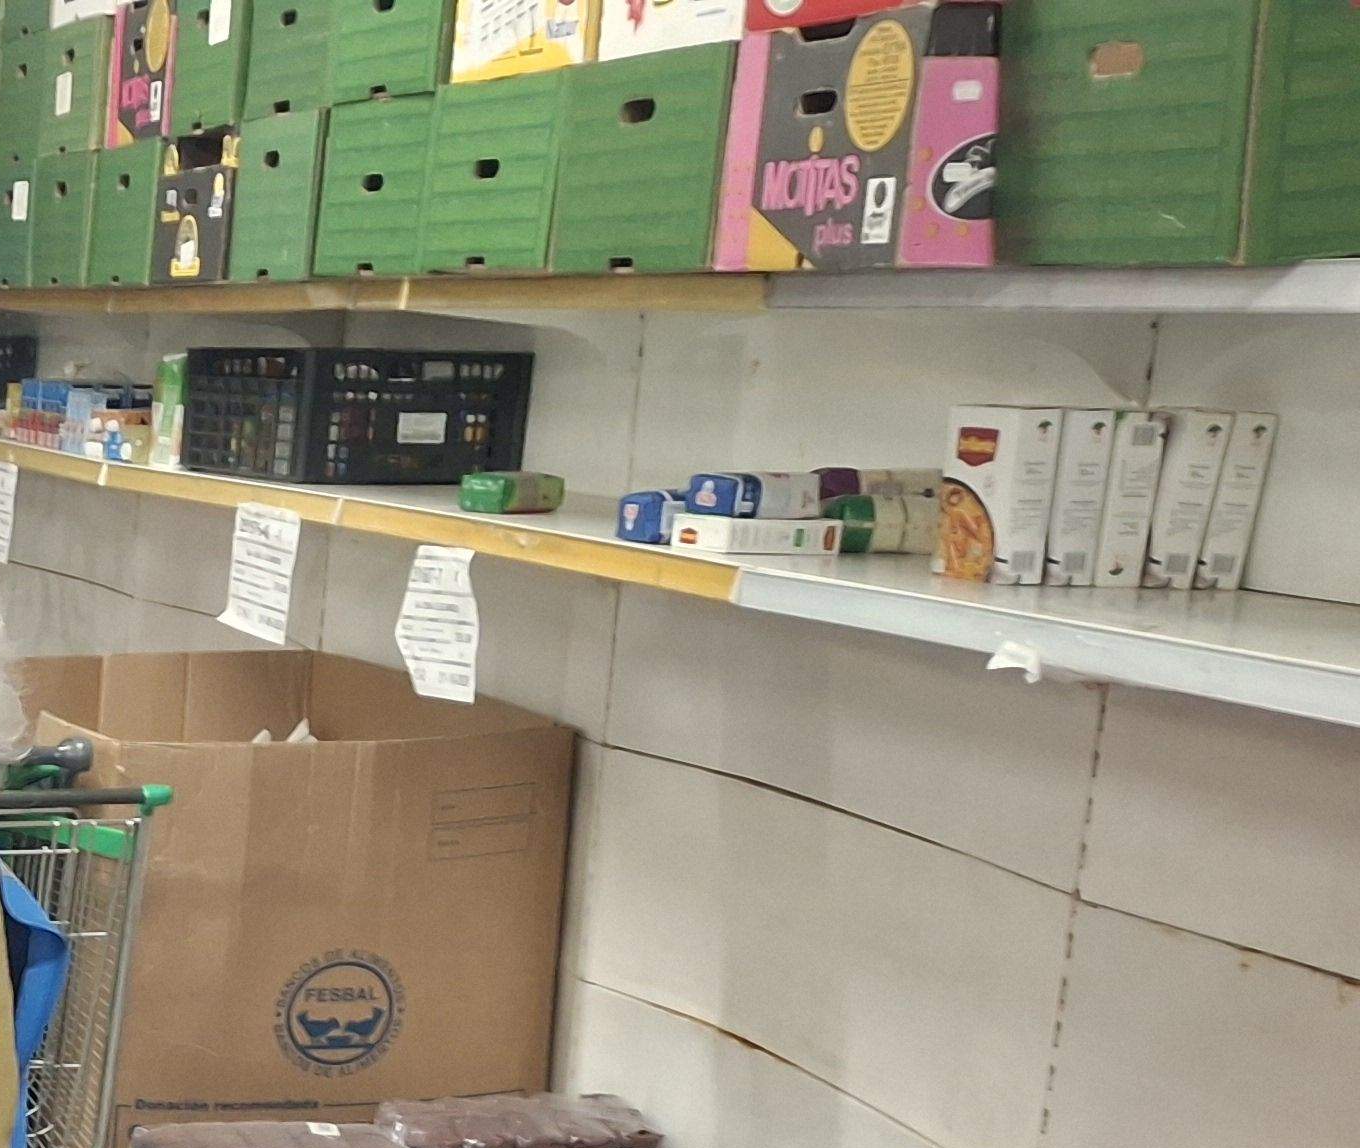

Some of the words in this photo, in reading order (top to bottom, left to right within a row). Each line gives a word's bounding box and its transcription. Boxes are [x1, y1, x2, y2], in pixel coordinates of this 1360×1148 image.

[762, 153, 861, 216] MOTITAS
[811, 217, 856, 256] plus
[303, 987, 382, 1003] FESBAL
